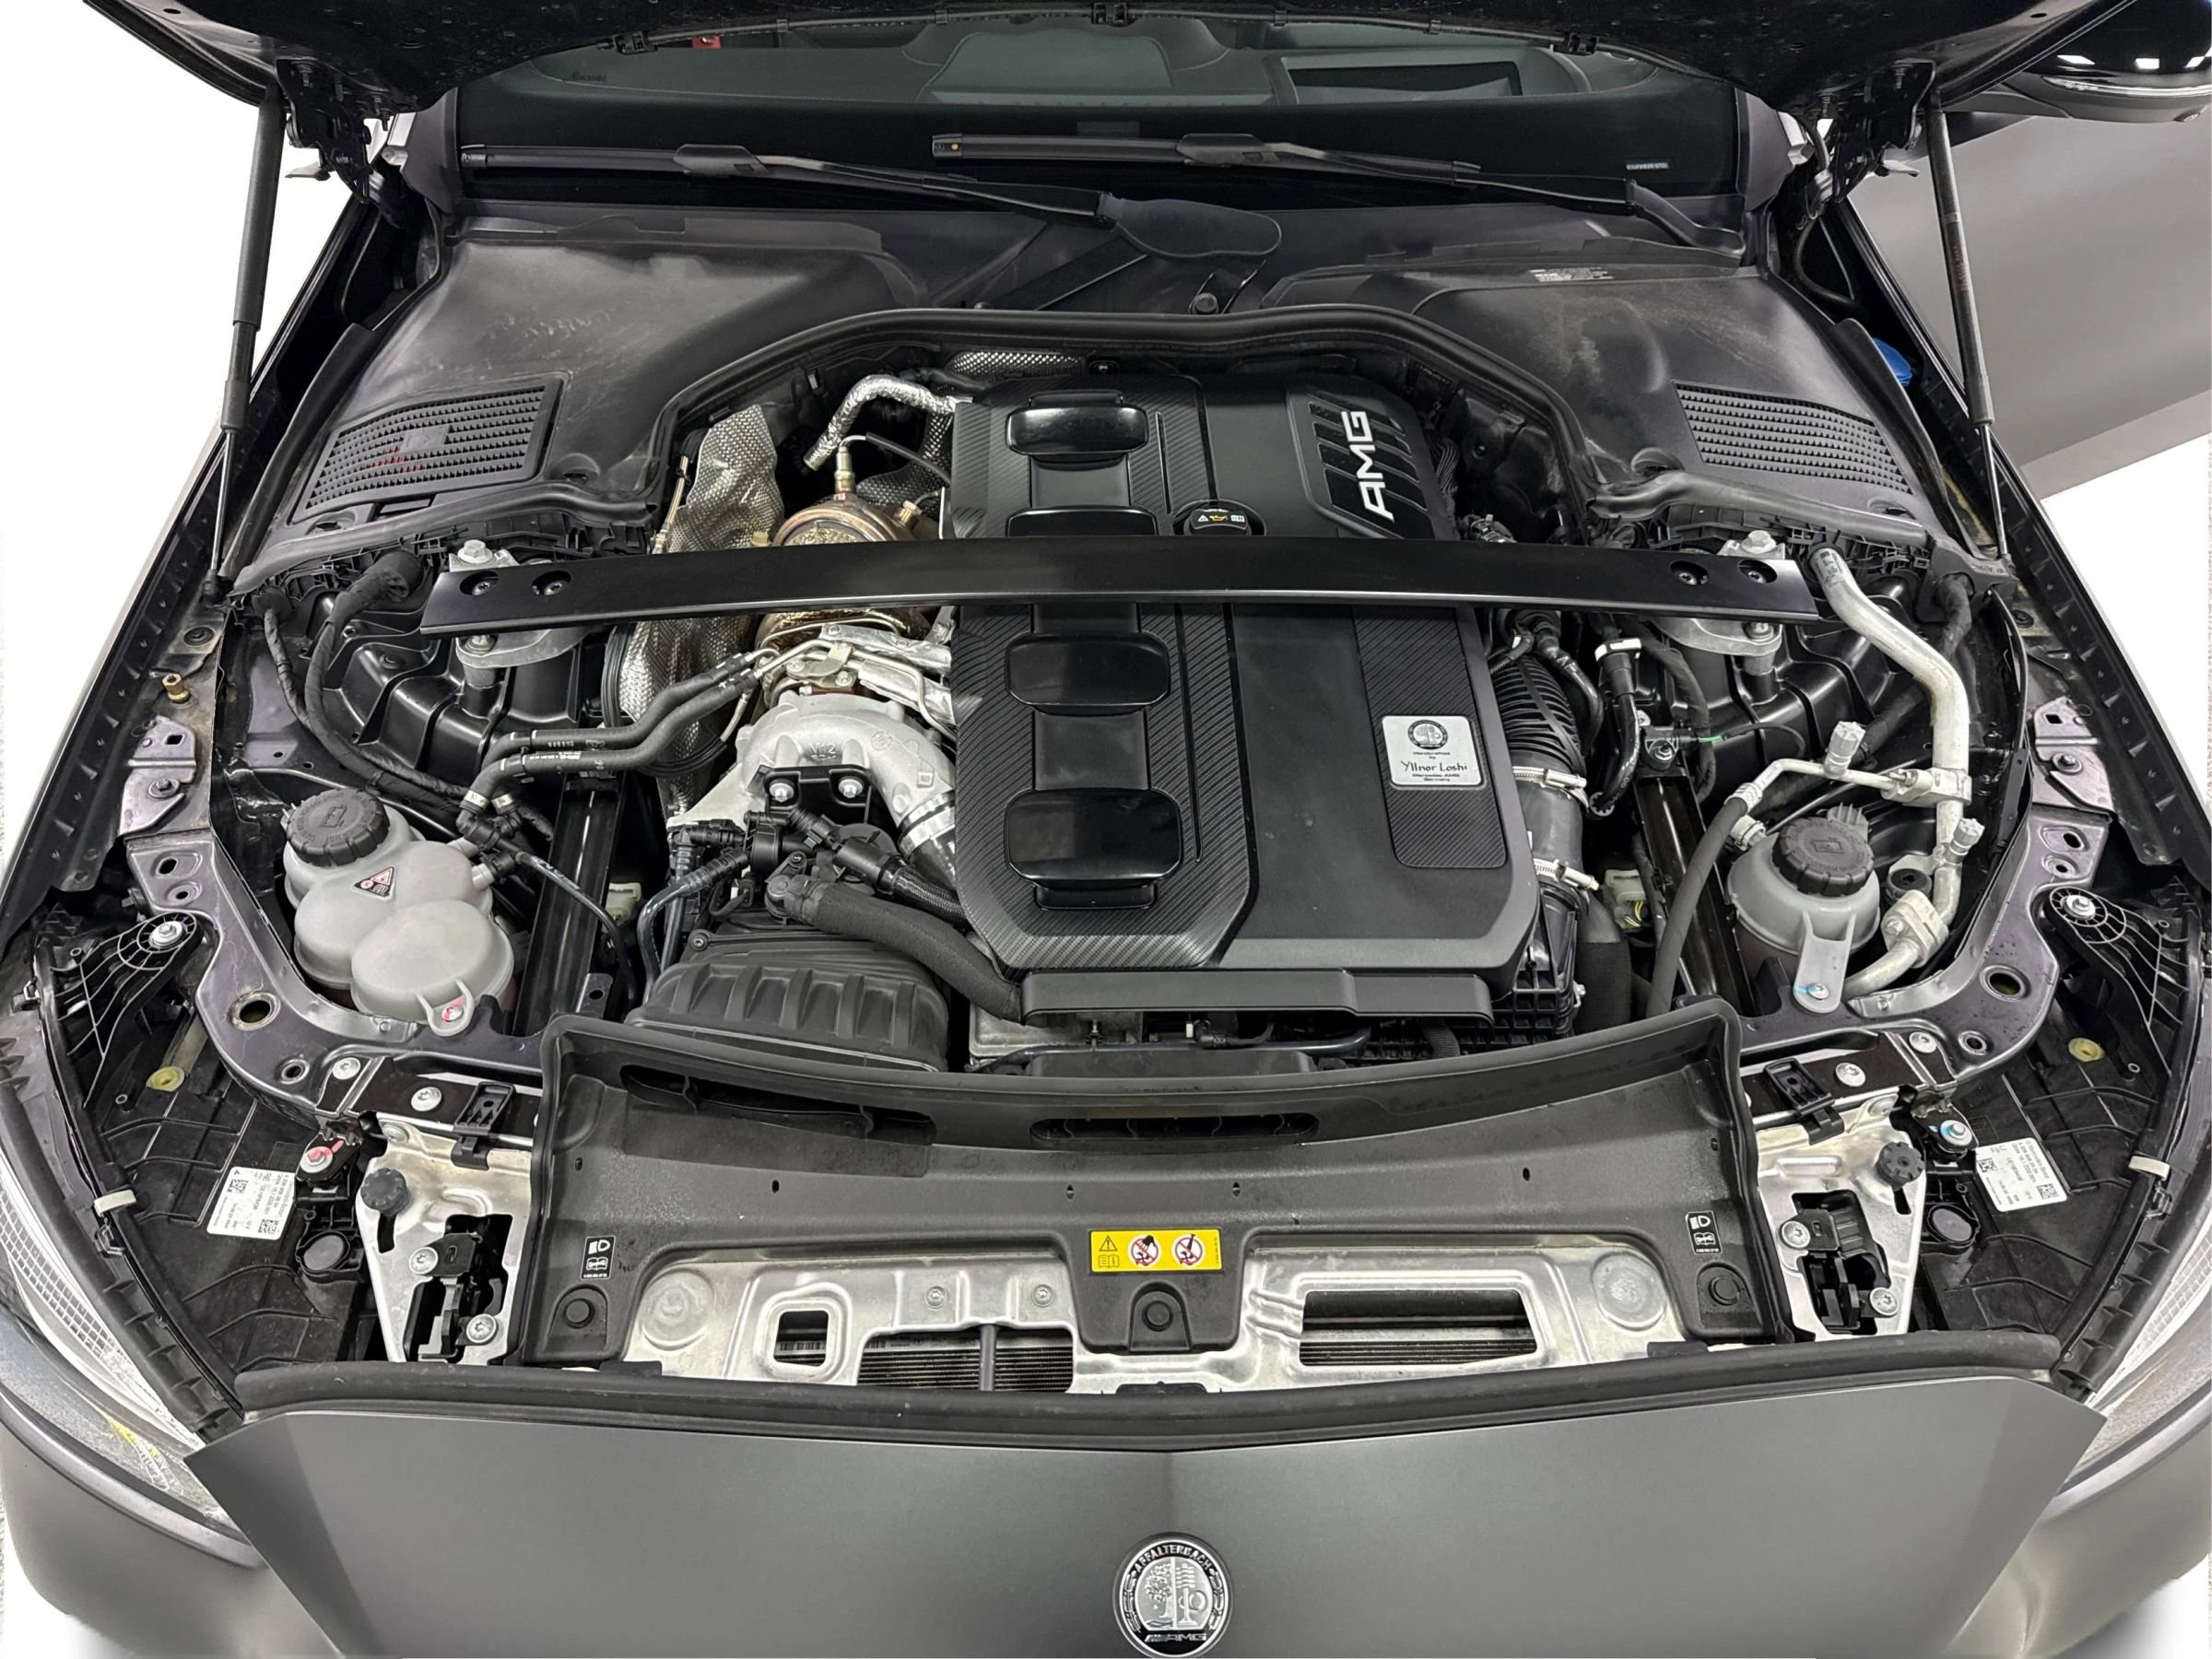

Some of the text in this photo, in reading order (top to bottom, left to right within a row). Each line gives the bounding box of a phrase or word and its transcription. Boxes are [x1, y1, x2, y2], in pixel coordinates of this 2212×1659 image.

[1341, 411, 1395, 523] AMG
[1440, 761, 1468, 772] Loshi
[1134, 1544, 1212, 1573] AFFALTERBACH
[1166, 1632, 1206, 1641] AMG
